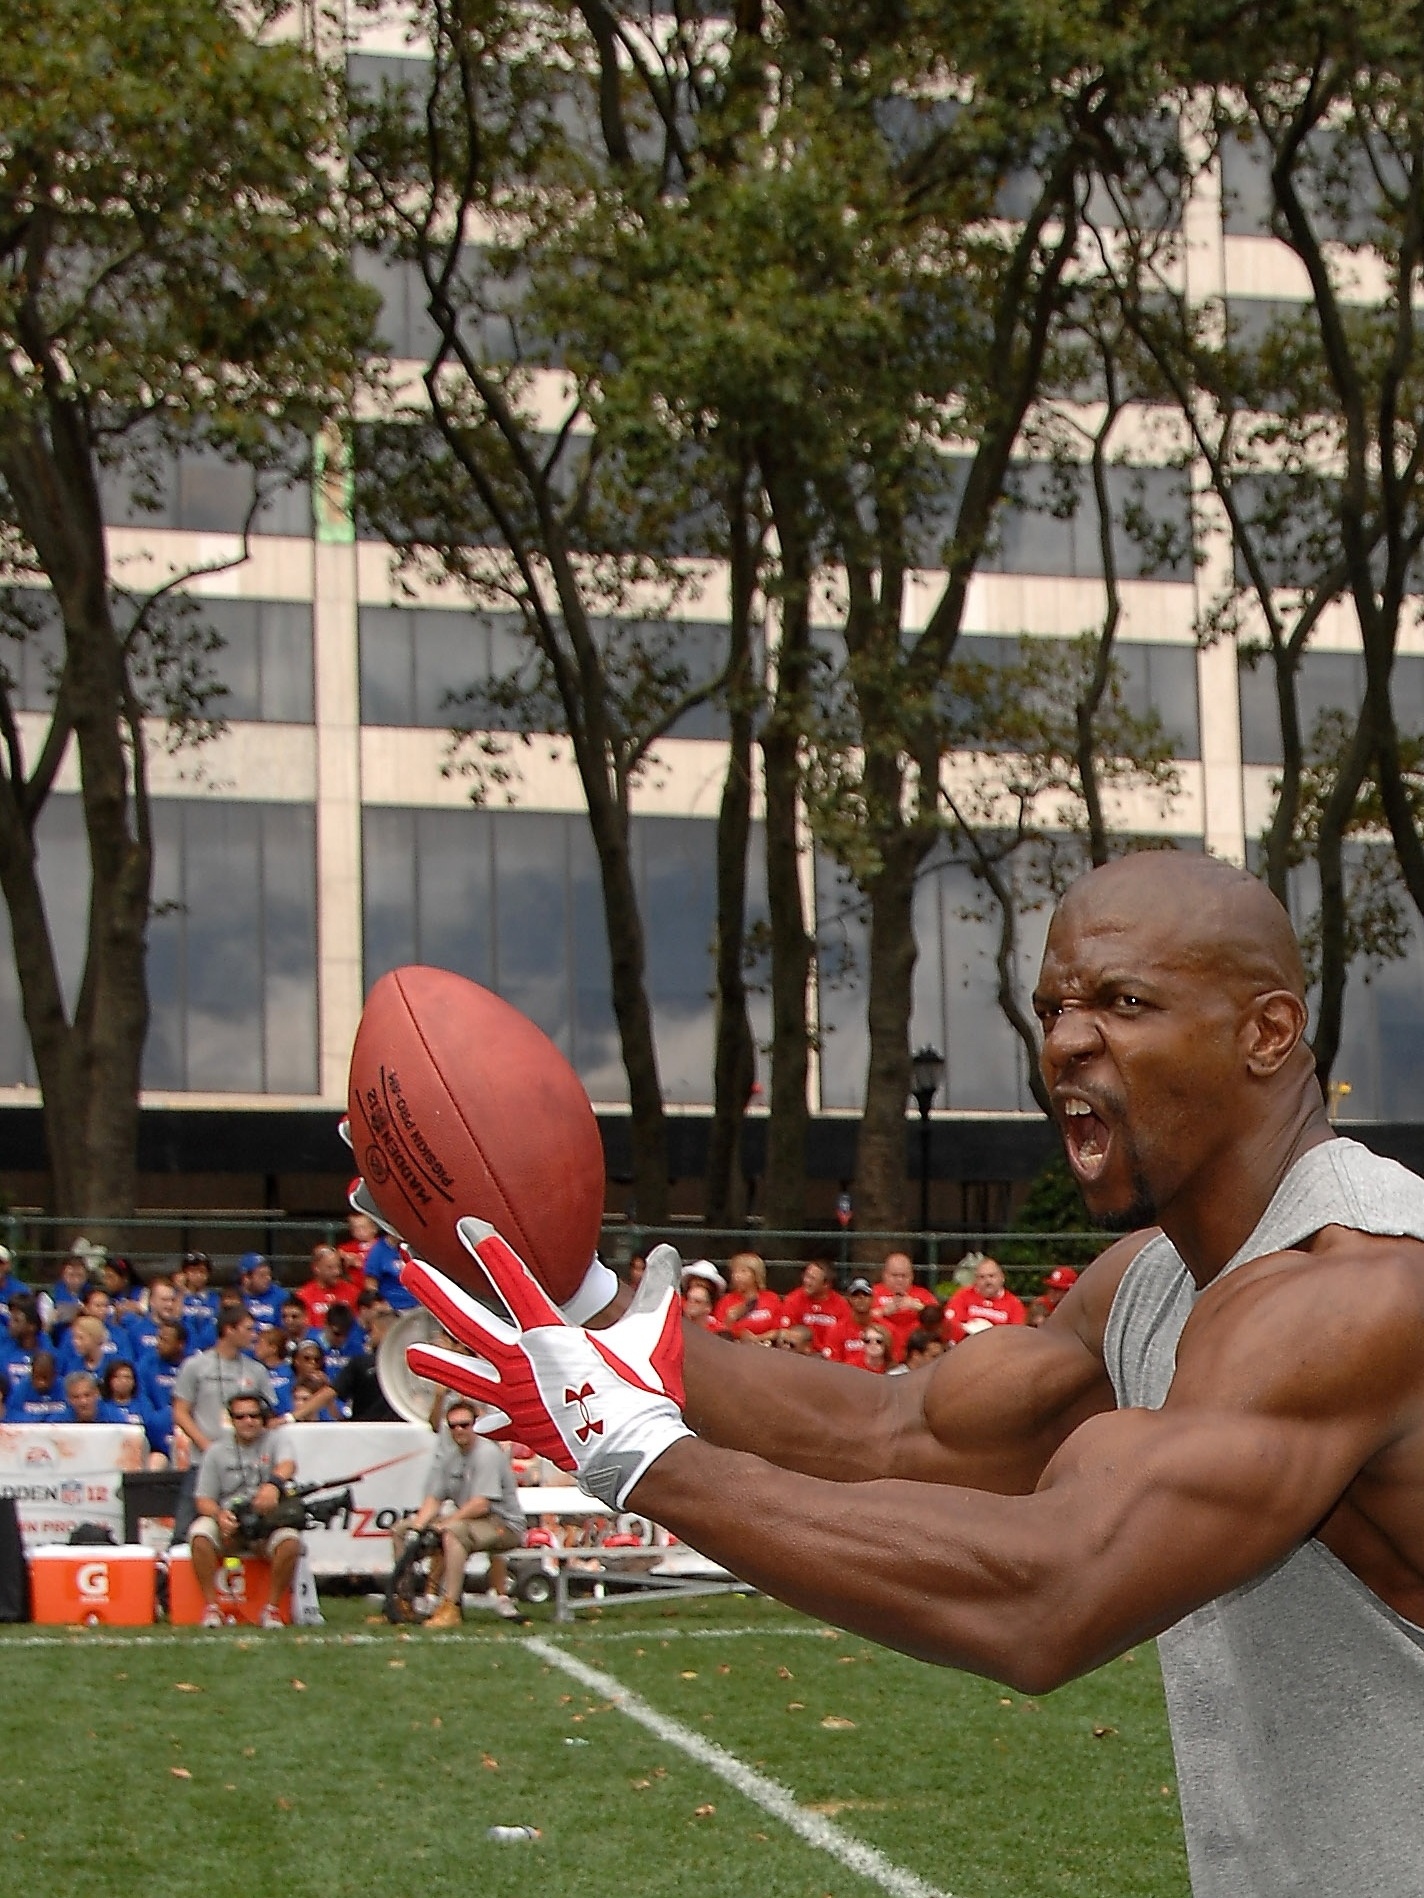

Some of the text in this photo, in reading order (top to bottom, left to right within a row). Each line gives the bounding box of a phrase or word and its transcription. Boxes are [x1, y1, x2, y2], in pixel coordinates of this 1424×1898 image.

[381, 1131, 432, 1204] MADDEN
[411, 1129, 455, 1188] PIGSKIN
[0, 1485, 58, 1500] DDEN
[87, 1486, 109, 1502] 12
[77, 1562, 109, 1595] G
